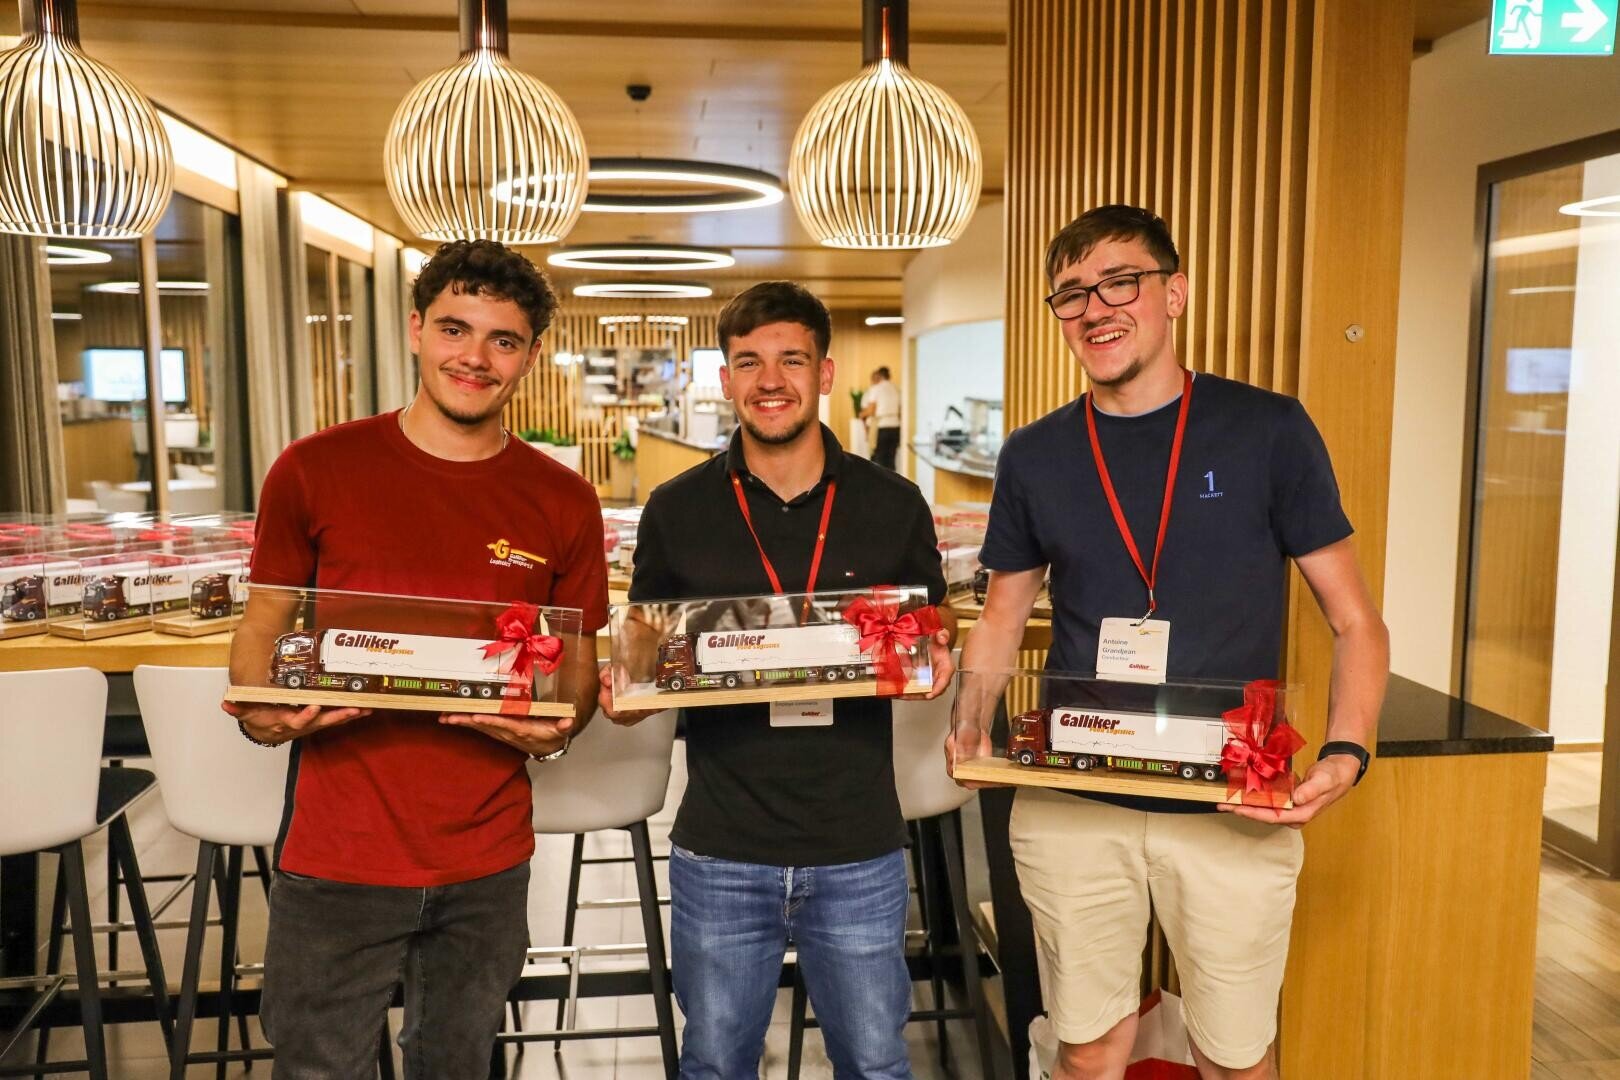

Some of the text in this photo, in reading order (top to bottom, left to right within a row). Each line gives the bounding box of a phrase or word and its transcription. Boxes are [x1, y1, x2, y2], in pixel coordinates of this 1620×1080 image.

[1203, 470, 1214, 491] 1
[335, 633, 399, 649] Galliker
[707, 633, 765, 648] Galliker
[1102, 638, 1128, 646] Antoine
[1060, 713, 1120, 730] Galliker
